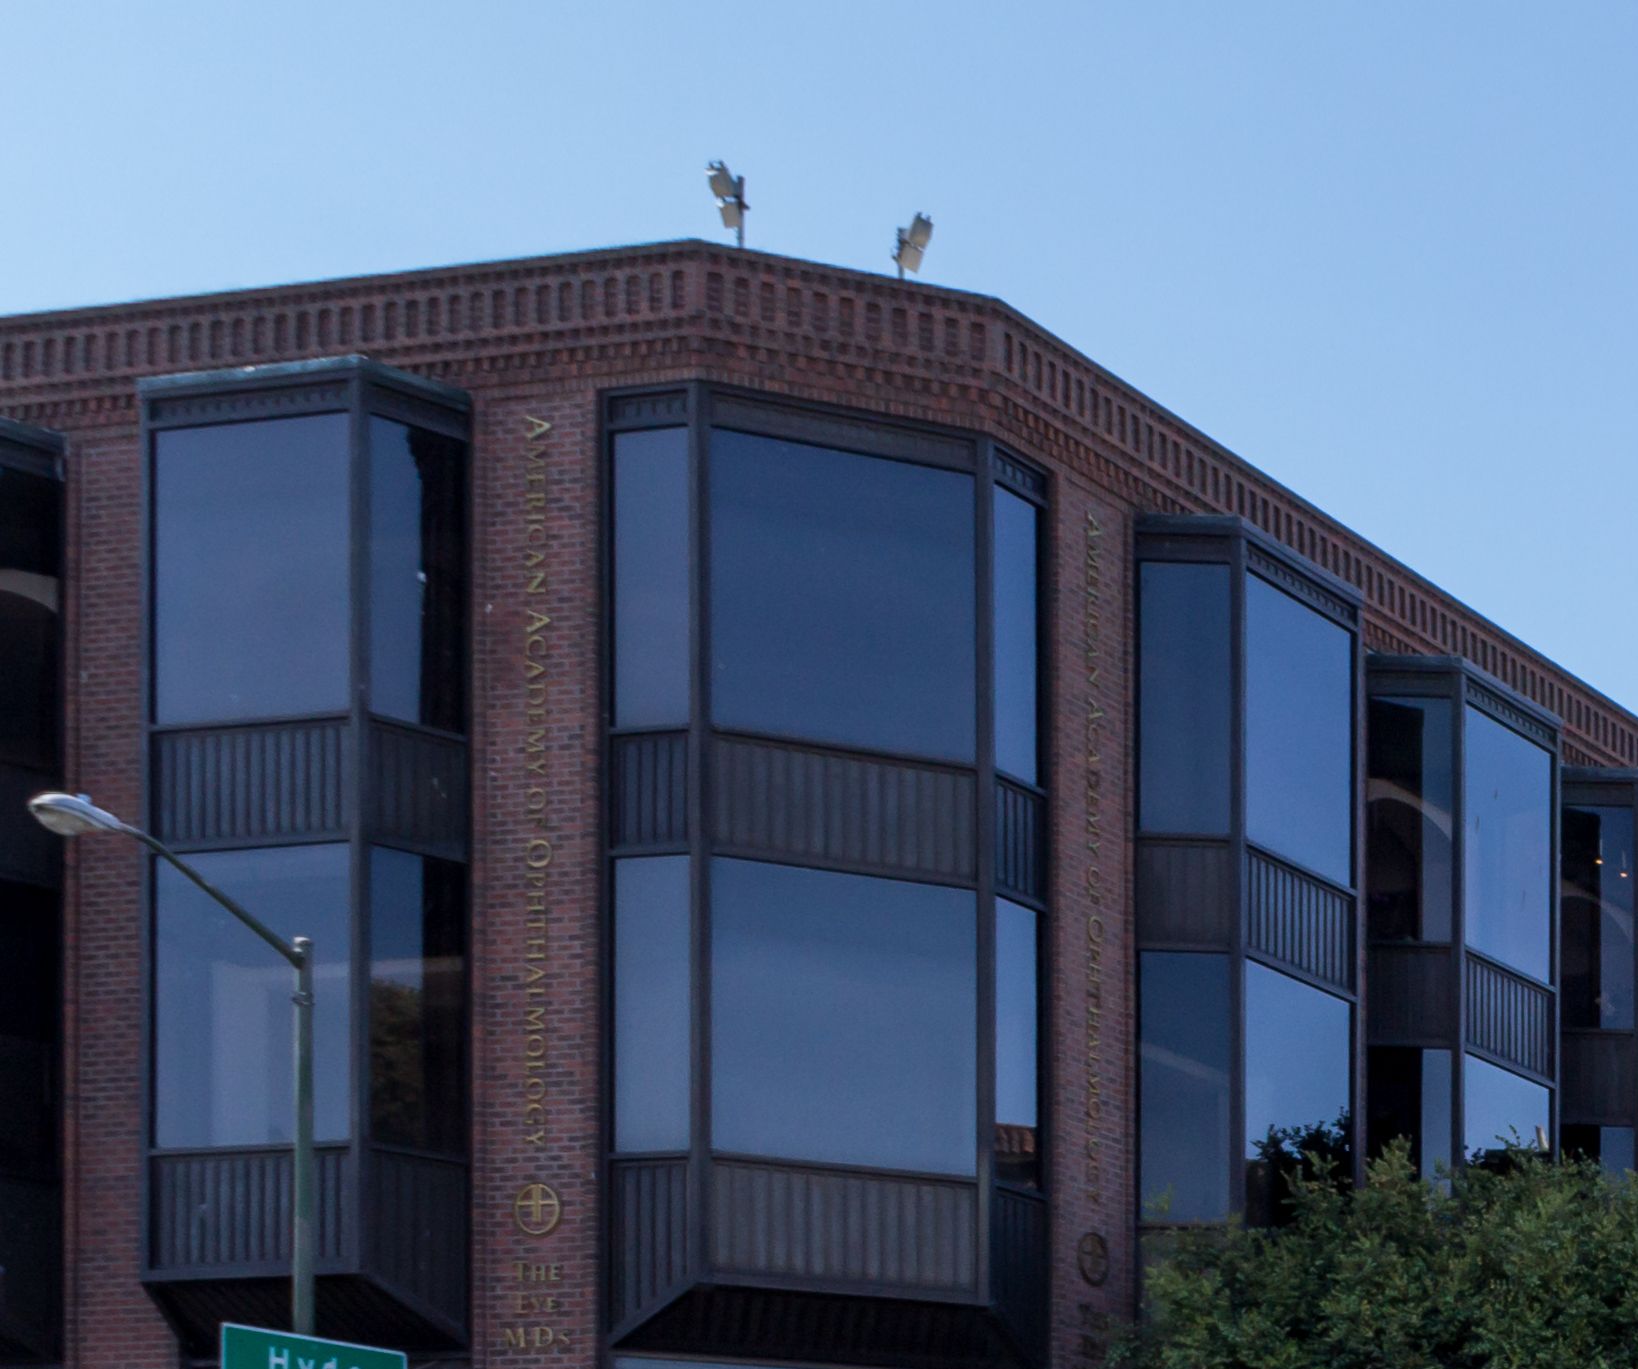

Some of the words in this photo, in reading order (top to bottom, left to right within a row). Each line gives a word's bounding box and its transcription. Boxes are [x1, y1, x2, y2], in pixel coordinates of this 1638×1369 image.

[526, 416, 550, 593] AMERICAN
[526, 610, 550, 774] ACADEMY
[512, 1261, 562, 1280] THE
